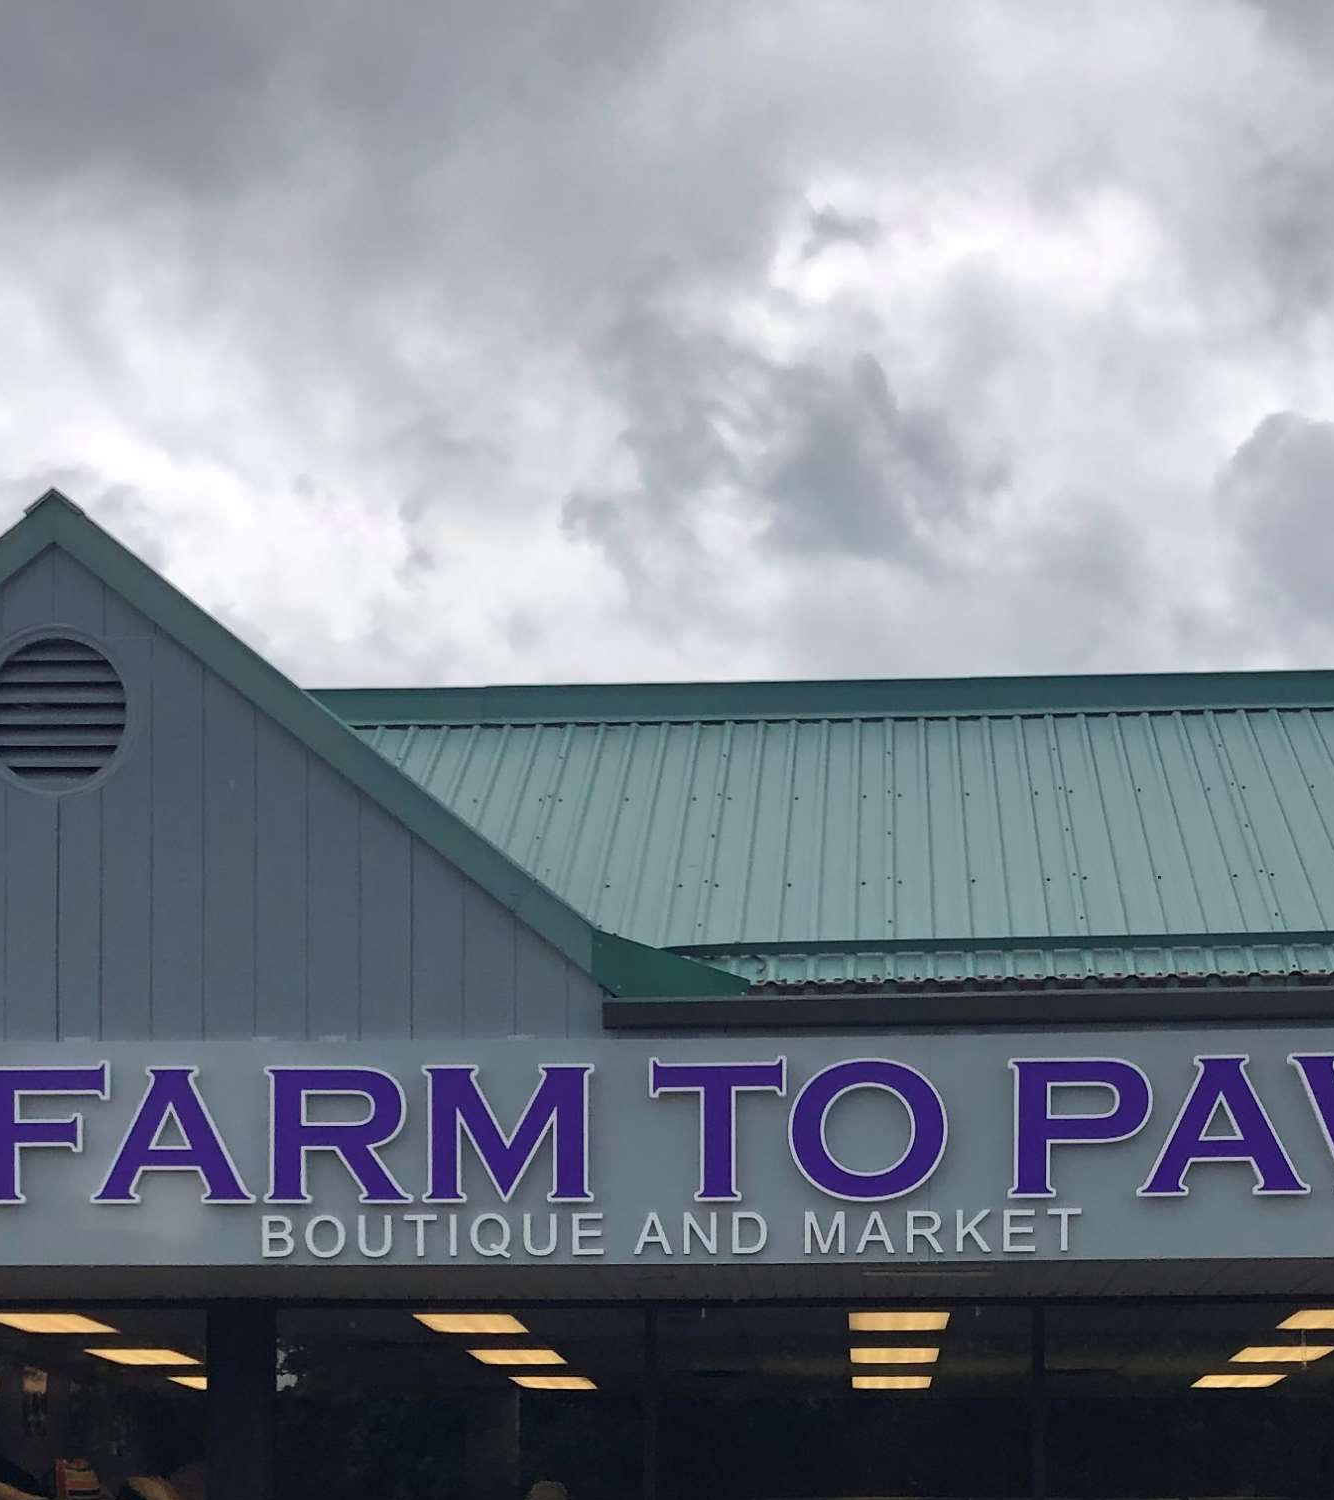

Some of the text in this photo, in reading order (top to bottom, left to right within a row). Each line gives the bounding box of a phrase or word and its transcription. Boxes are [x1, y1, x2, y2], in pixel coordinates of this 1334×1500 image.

[648, 1055, 949, 1202] TO
[261, 1207, 1083, 1260] BOUTIQUE AND MARKET
